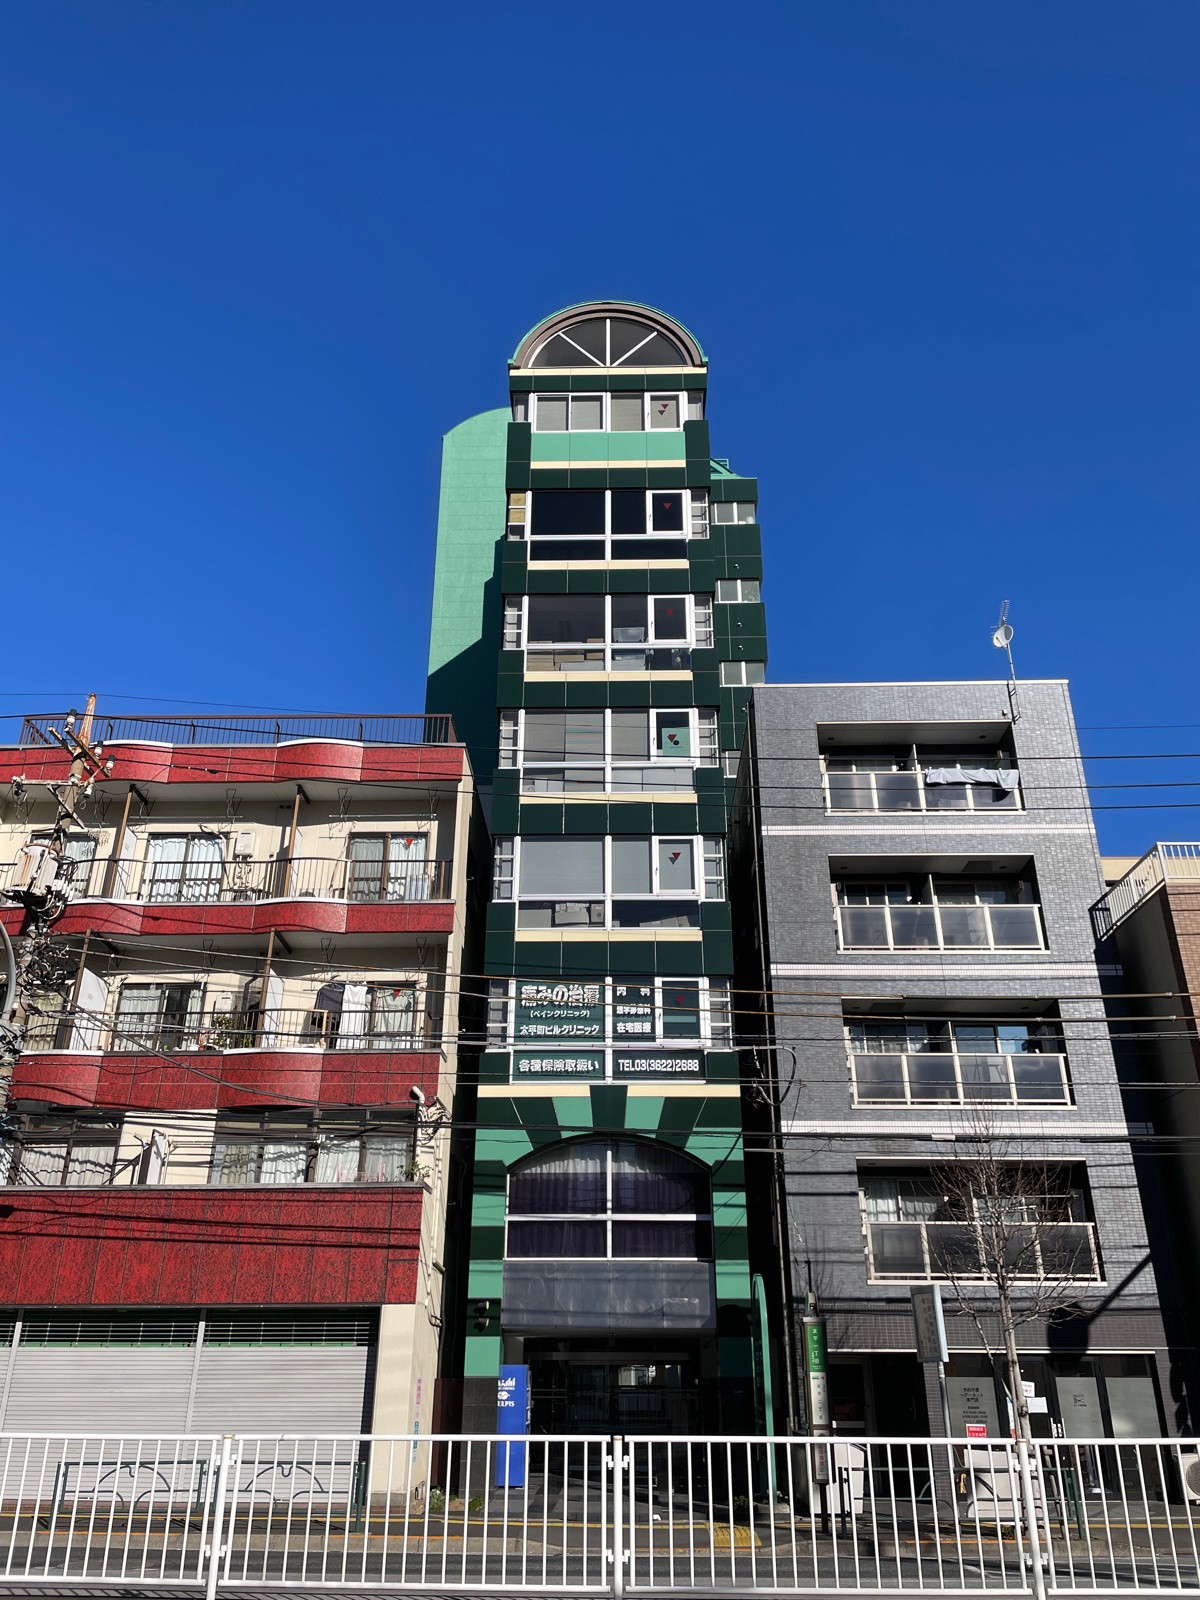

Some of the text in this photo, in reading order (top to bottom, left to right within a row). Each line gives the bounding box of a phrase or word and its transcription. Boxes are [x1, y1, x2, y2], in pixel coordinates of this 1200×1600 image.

[521, 984, 600, 1007] 痛みの治療
[530, 1010, 590, 1018] (ペインクリニック)
[520, 1025, 600, 1036] 太平町ビルクリニック
[616, 1022, 652, 1033] 在宅医療
[518, 1059, 600, 1072] 各種保険取扱い
